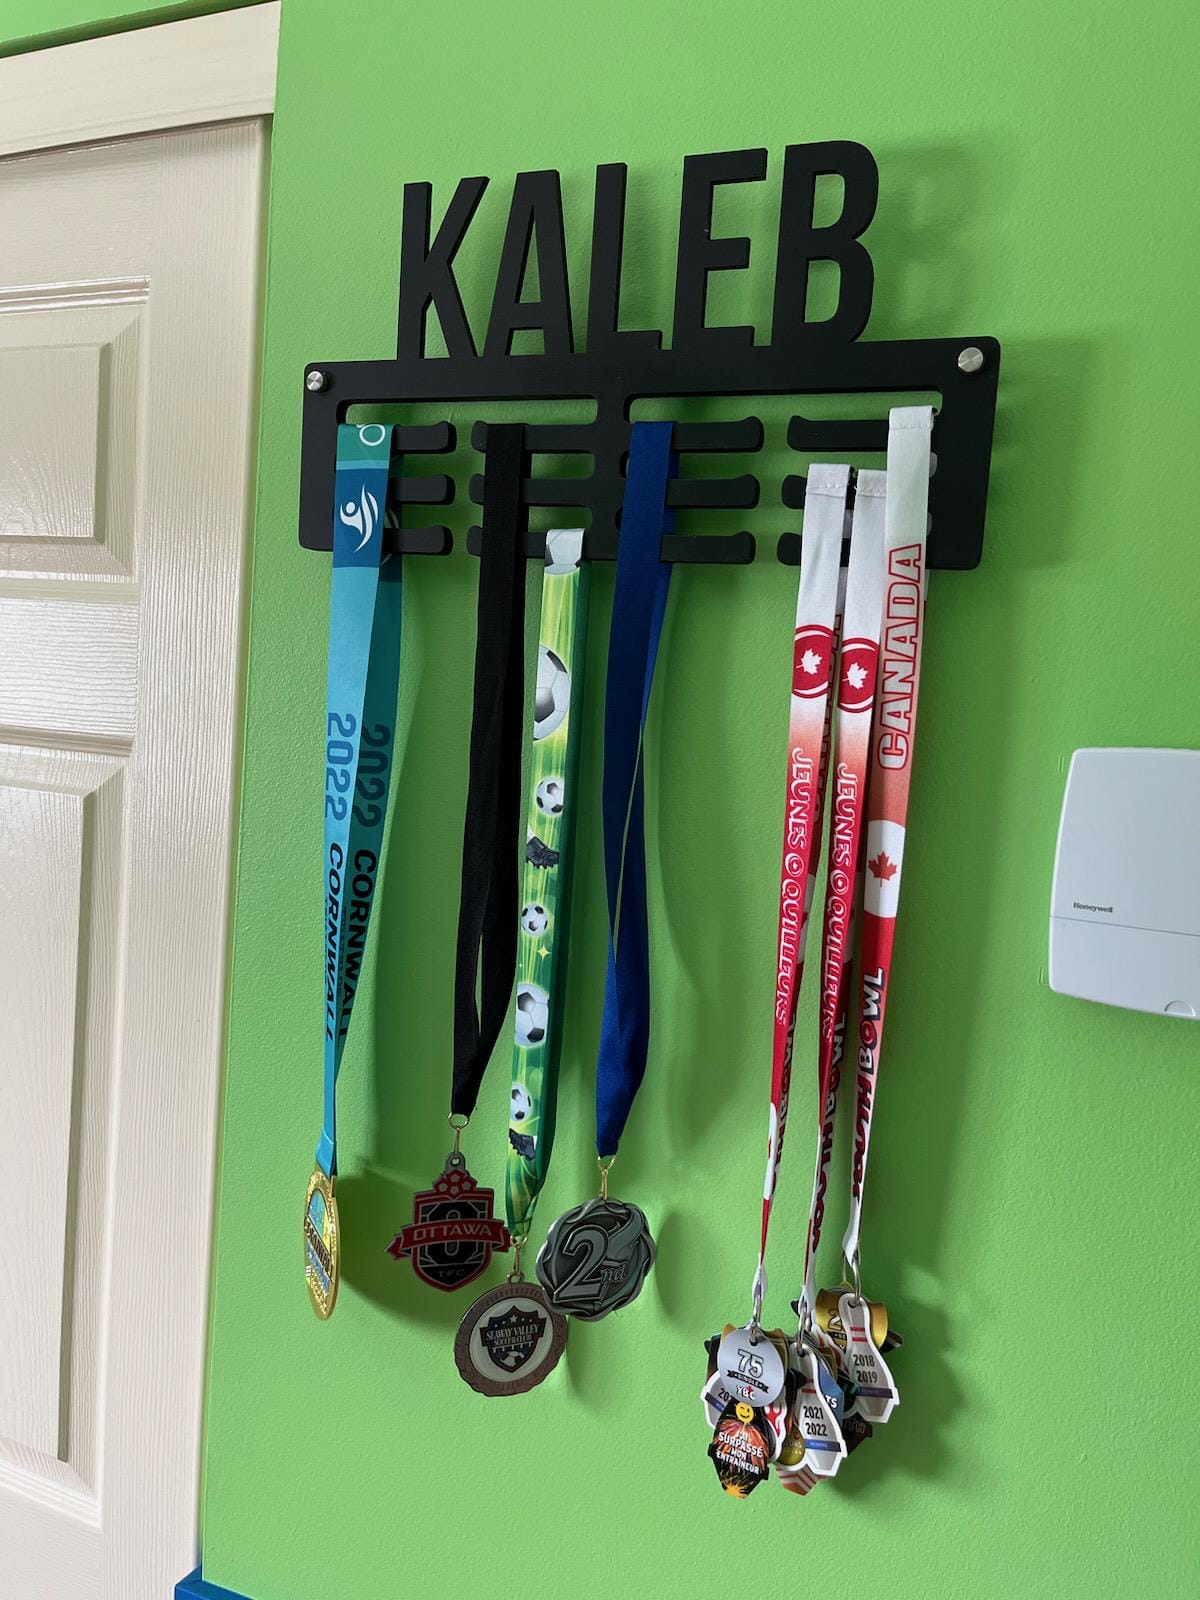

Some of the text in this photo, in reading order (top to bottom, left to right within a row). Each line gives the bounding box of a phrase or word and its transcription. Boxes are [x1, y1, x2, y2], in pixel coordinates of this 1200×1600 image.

[398, 140, 880, 360] KALEB
[878, 543, 922, 771] CANADA
[325, 712, 357, 822] 2022
[831, 762, 858, 868] JEUNES
[338, 723, 392, 1039] 2022 CORNWALL
[775, 747, 813, 1026] JEUNES QUILLEURS
[1073, 901, 1113, 913] Honeywell
[325, 842, 344, 1042] CORNWALL
[857, 966, 884, 1075] BOWL
[413, 1223, 493, 1241] OTTAWA
[513, 1323, 540, 1337] VALLEY
[737, 1348, 765, 1379] 75
[853, 1353, 876, 1367] 2018
[856, 1370, 878, 1384] 2019
[803, 1405, 824, 1420] 2021
[805, 1422, 828, 1437] 2022
